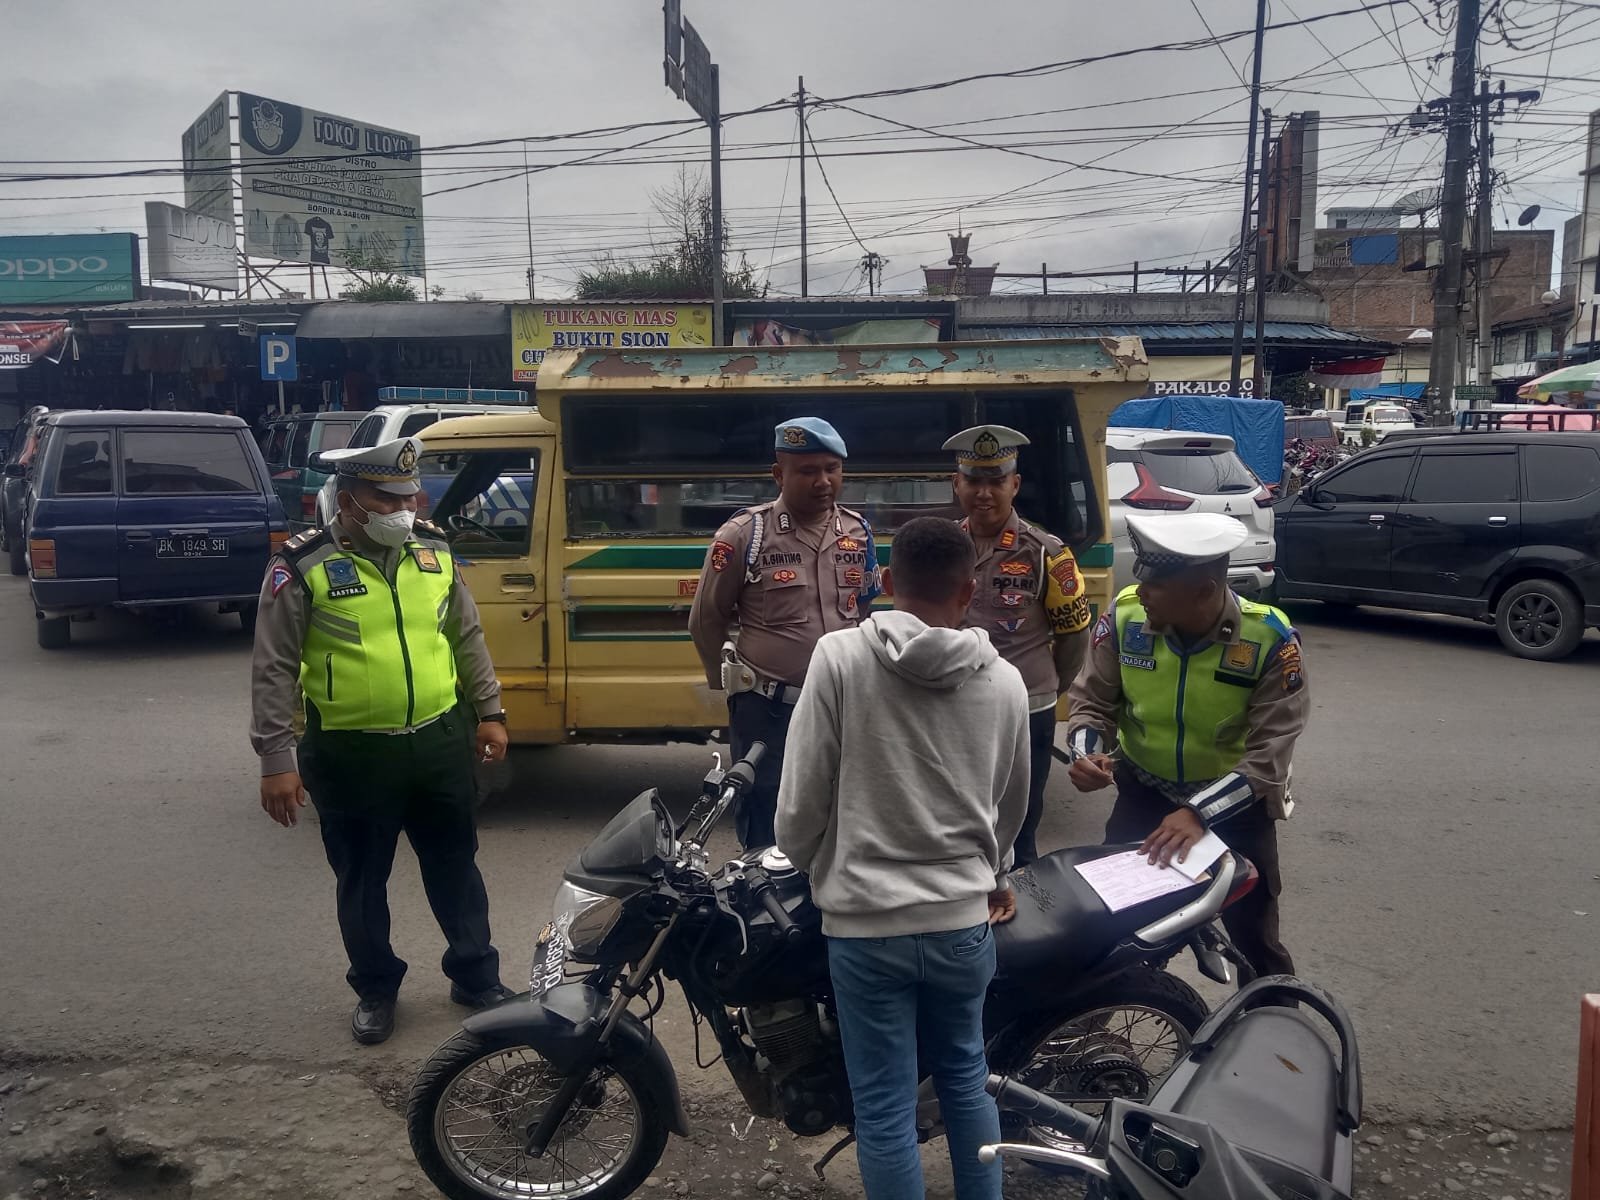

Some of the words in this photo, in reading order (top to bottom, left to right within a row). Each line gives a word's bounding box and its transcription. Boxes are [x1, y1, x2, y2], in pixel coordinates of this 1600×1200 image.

[313, 117, 357, 148] TOKO
[365, 129, 411, 159] LLOYD
[345, 156, 377, 169] DISTRO
[274, 168, 299, 182] PRIA
[302, 173, 345, 191] DEWASA
[348, 182, 356, 193] &
[358, 185, 397, 201] REMAJA
[307, 203, 335, 215] BORDIR
[343, 209, 371, 221] SABLON
[543, 309, 629, 326] TUKANG
[632, 309, 678, 326] MAS
[553, 331, 615, 347] BUKIT
[621, 331, 670, 347] SION
[266, 340, 290, 375] P
[159, 540, 174, 553] BK
[182, 540, 208, 551] 1849
[212, 540, 225, 551] SH
[993, 577, 1035, 590] POLRI
